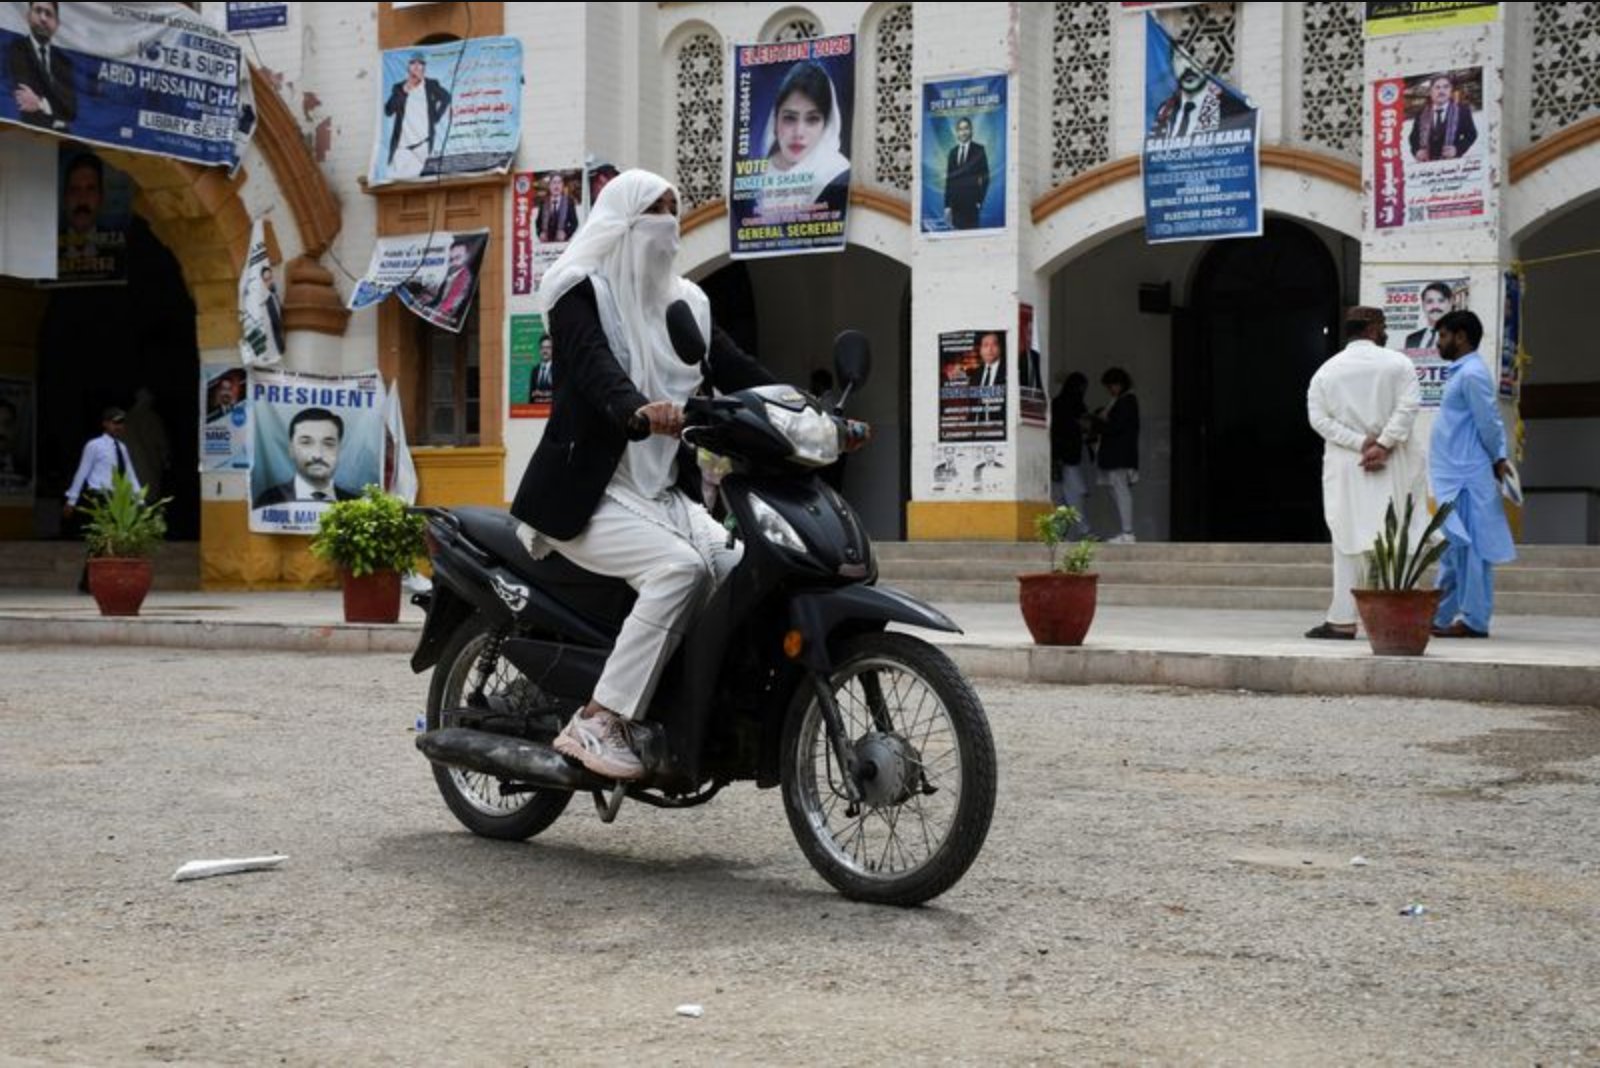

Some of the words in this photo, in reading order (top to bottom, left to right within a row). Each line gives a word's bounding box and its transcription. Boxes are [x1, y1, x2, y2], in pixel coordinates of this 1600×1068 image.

[181, 51, 191, 69] &
[740, 41, 809, 67] ELECTION
[97, 61, 136, 86] ABID
[139, 69, 206, 101] HUSSAIN
[144, 112, 191, 132] LIBRARY
[1215, 128, 1252, 145] KAKA
[1216, 145, 1246, 155] COURT
[736, 159, 768, 175] VOTE
[737, 225, 784, 241] GENERAL
[787, 222, 844, 238] SECRETARY
[1386, 293, 1418, 304] 2026
[1415, 366, 1449, 380] OTE
[253, 383, 377, 408] PRESIDENT
[205, 432, 231, 441] MMC
